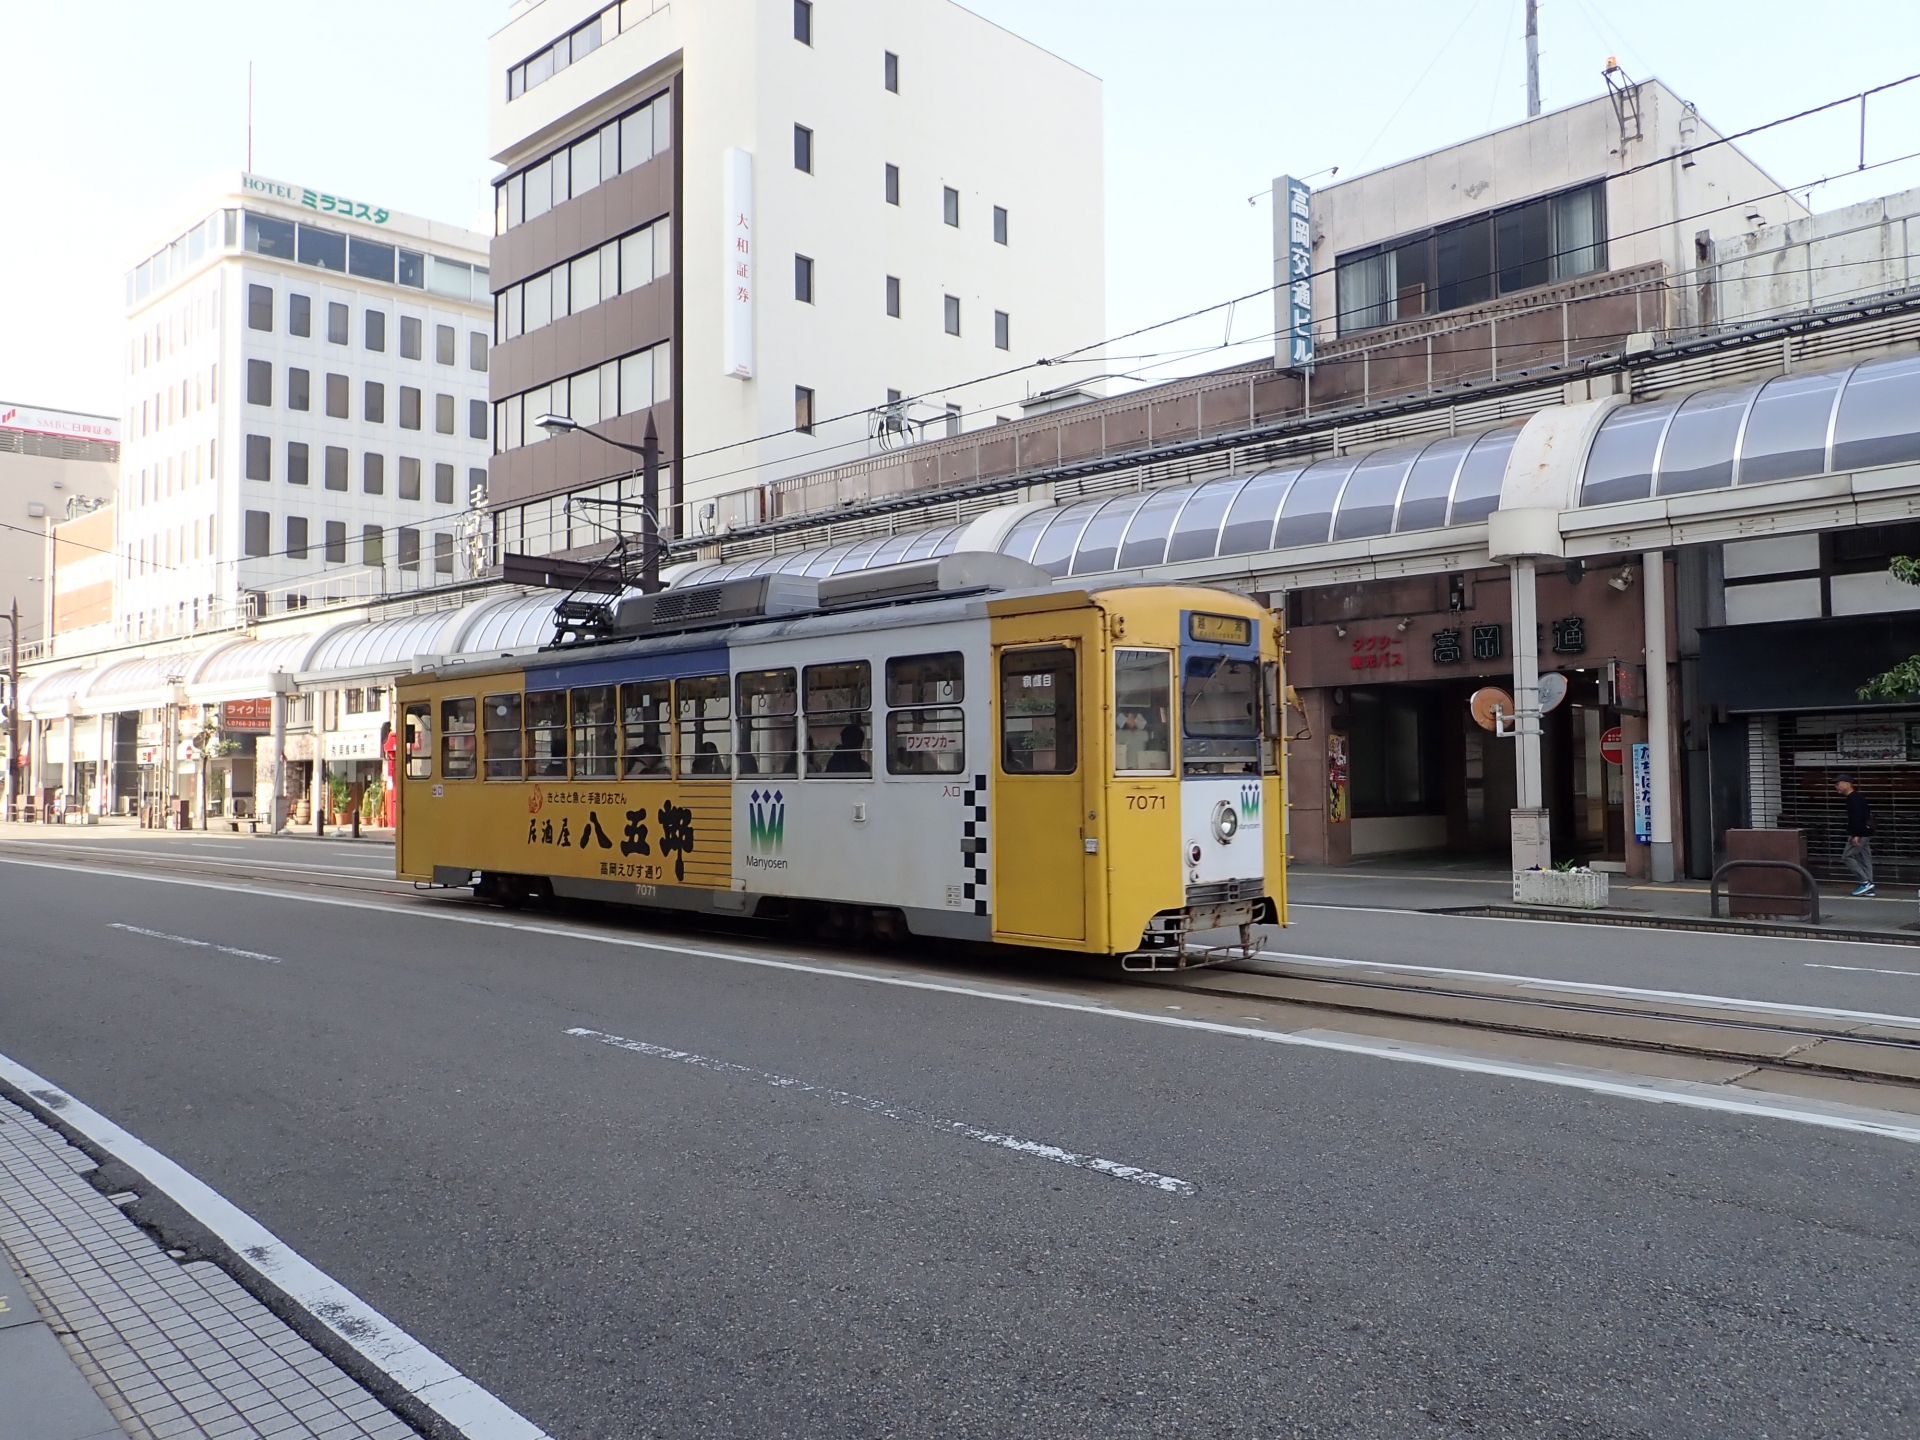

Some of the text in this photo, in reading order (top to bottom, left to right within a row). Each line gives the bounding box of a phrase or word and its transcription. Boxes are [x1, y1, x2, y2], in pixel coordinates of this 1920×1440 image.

[243, 176, 389, 224] HOTEL ミラコスタ
[736, 213, 749, 303] 大和証券
[1290, 186, 1313, 363] 高岡交通ビル
[36, 418, 112, 436] SMBC日興証券
[1352, 636, 1402, 651] タクシー
[1432, 617, 1586, 665] 高岡通
[907, 735, 956, 749] ワンマンカー
[432, 786, 442, 796] 出口
[942, 785, 961, 797] 入口
[1125, 795, 1165, 810] 7071
[600, 862, 663, 880] 高岡えびす通り
[746, 855, 788, 871] Manyosen
[636, 884, 656, 897] 7071
